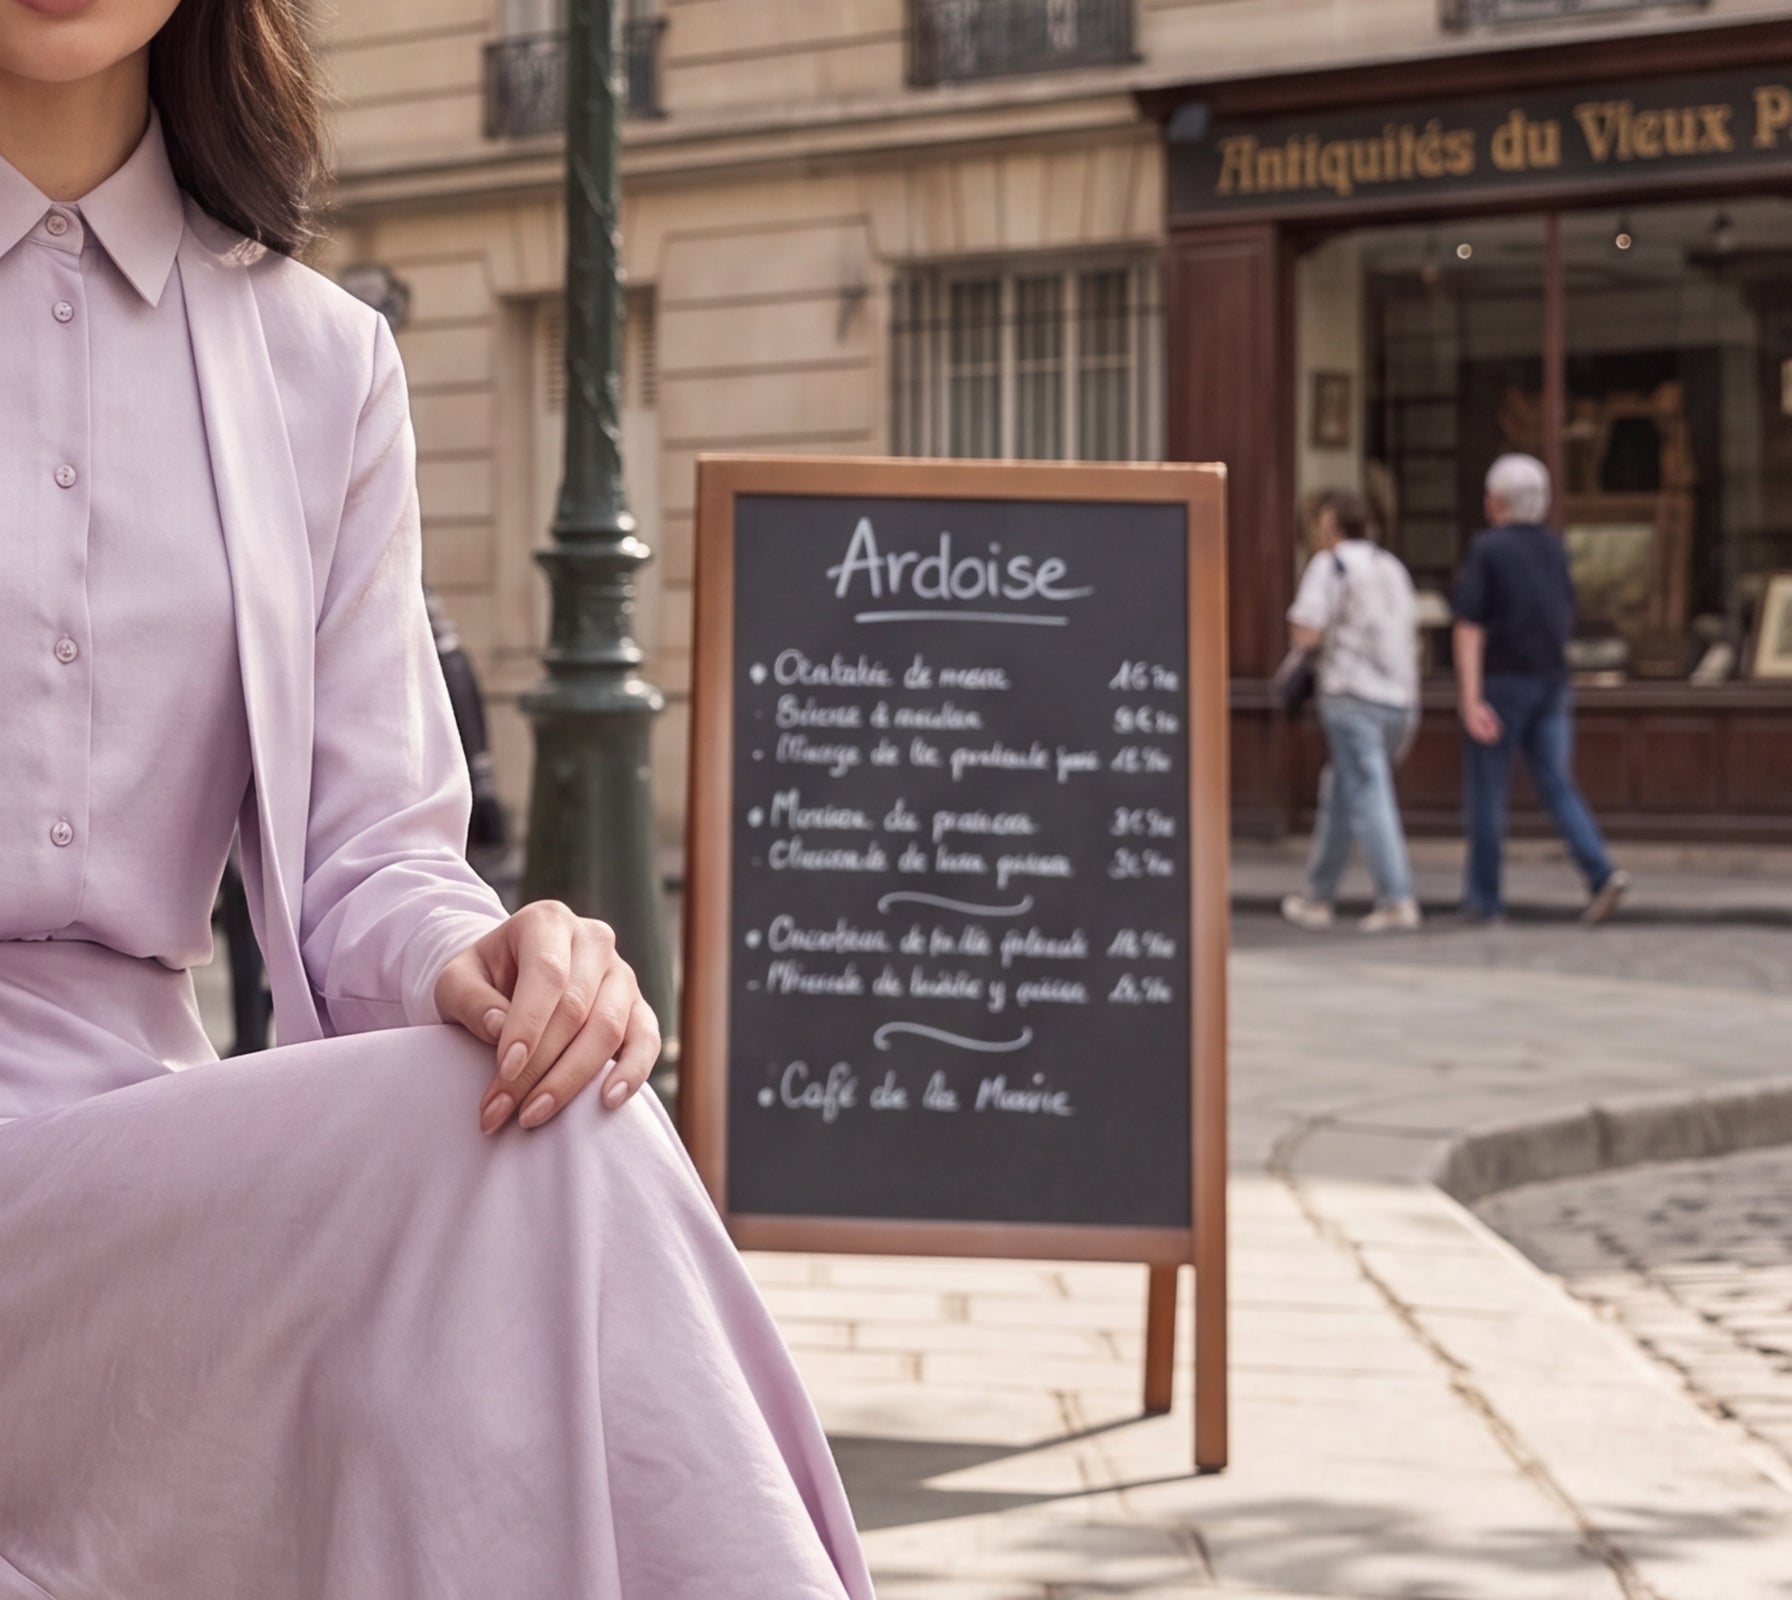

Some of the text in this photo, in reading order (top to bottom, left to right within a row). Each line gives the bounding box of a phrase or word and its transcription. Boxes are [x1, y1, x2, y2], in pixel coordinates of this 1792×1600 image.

[1215, 116, 1476, 198] Antiquités
[1490, 107, 1562, 172] du
[1752, 83, 1792, 150] P
[825, 515, 1095, 602] Ardoise
[779, 1059, 859, 1124] Café
[869, 1068, 909, 1111] de
